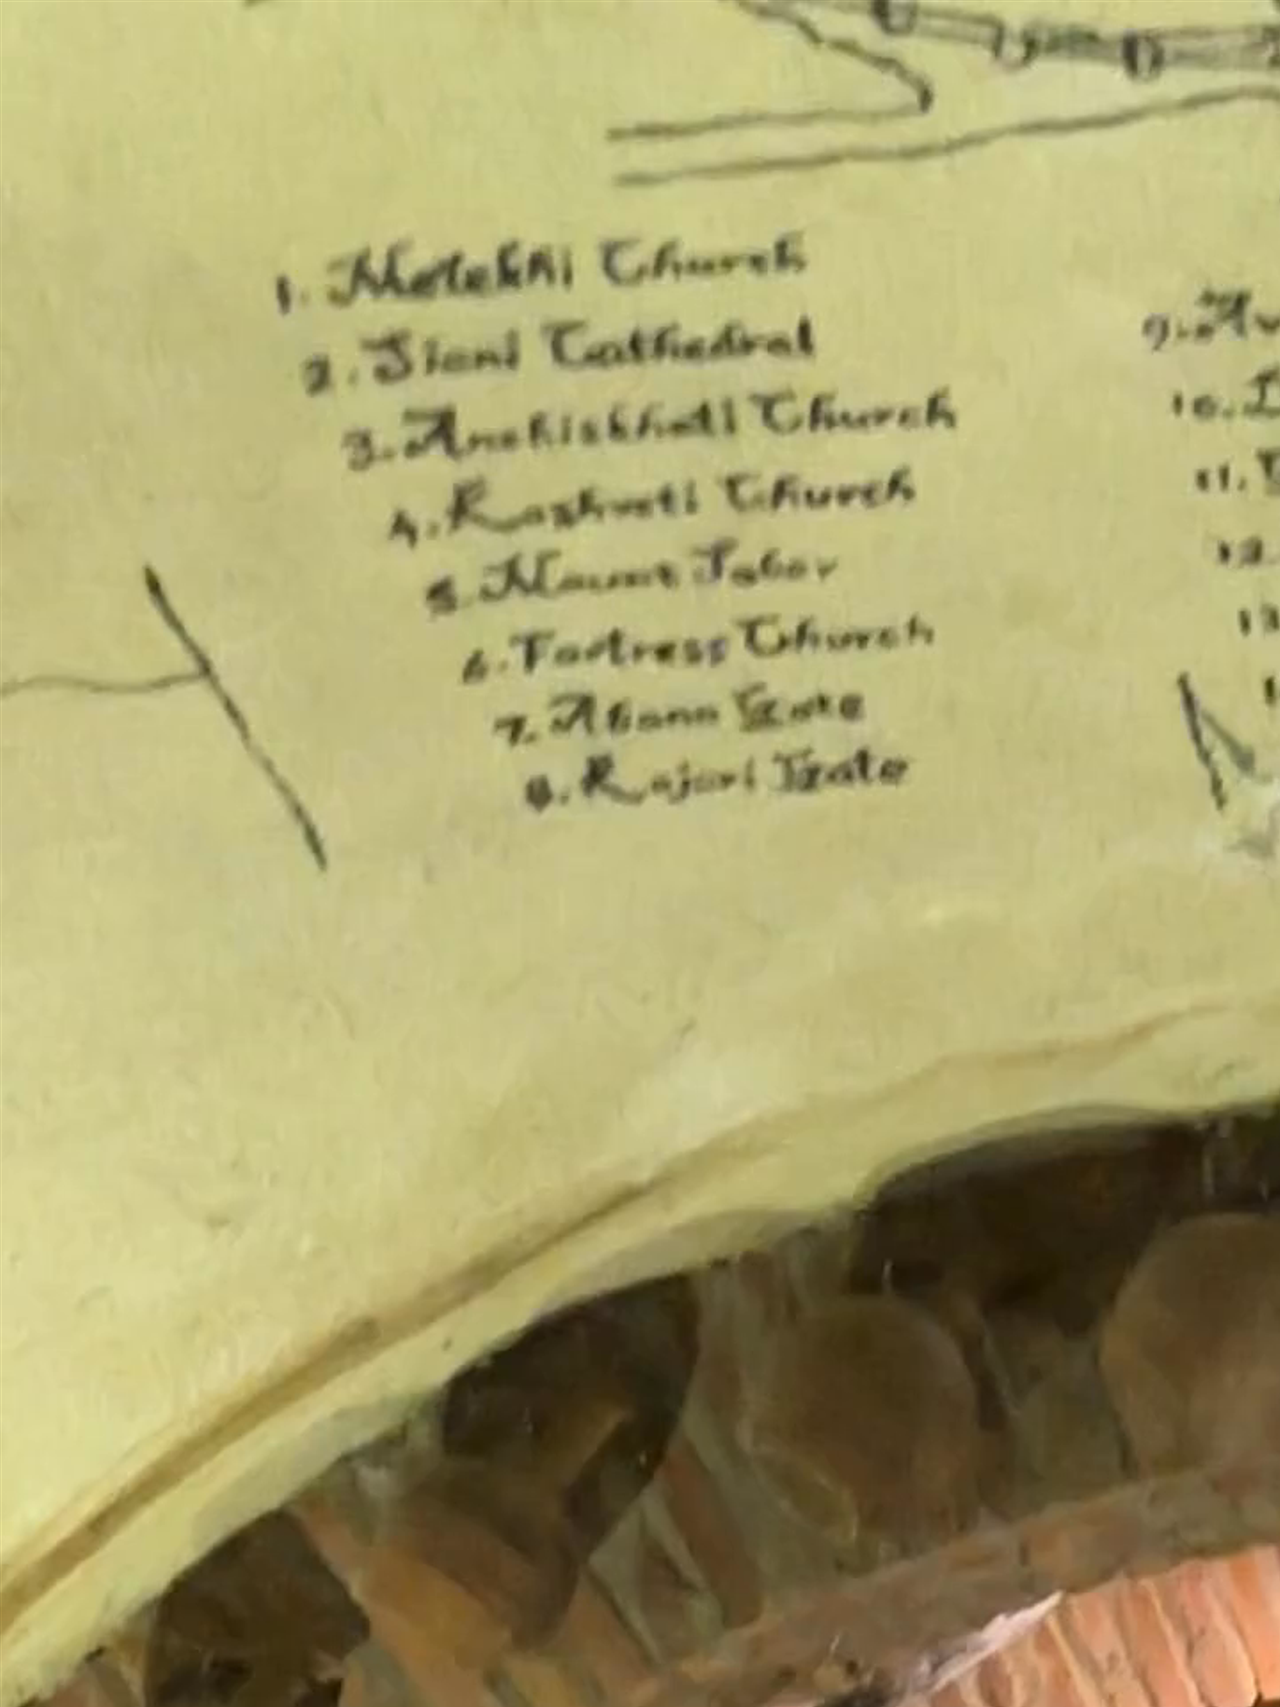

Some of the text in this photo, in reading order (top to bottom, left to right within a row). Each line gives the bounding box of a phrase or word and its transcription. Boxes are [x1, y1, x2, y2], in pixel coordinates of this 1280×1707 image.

[600, 230, 806, 287] Church
[542, 315, 815, 369] Cathedral
[748, 385, 958, 437] Church
[716, 462, 917, 514] Church
[690, 536, 839, 589] Tabor
[509, 625, 730, 676] Fortress
[734, 612, 935, 658] Church
[733, 680, 865, 732] Gate
[773, 745, 910, 792] Gate
